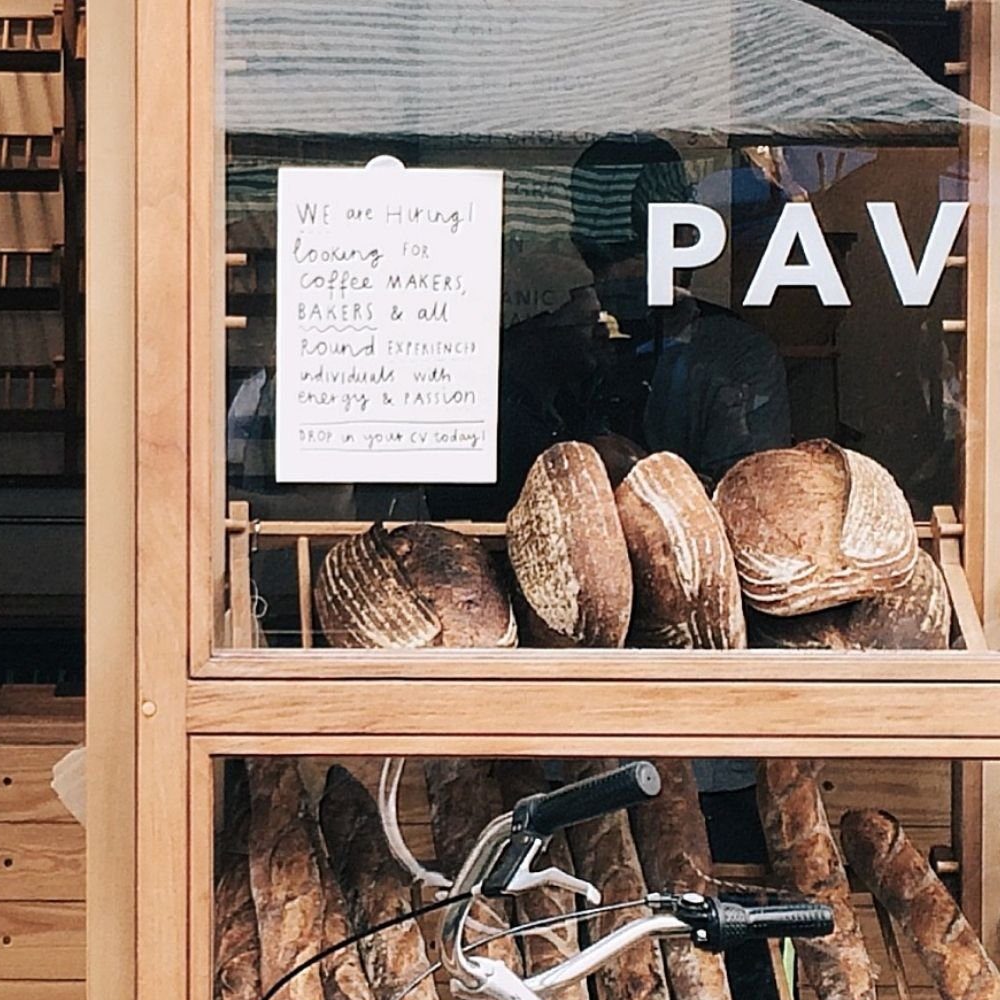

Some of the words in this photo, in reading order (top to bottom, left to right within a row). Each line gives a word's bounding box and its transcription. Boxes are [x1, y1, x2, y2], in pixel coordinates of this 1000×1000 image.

[346, 205, 373, 221] are
[402, 241, 429, 258] FOR
[647, 202, 970, 307] PAV
[386, 274, 467, 296] MAKERS,
[298, 303, 373, 322] BAKERS
[417, 303, 448, 322] all
[299, 365, 395, 384] individuals
[413, 367, 451, 383] with
[298, 388, 371, 412] energy
[298, 429, 334, 443] DROP
[341, 432, 355, 442] in
[363, 430, 403, 449] your
